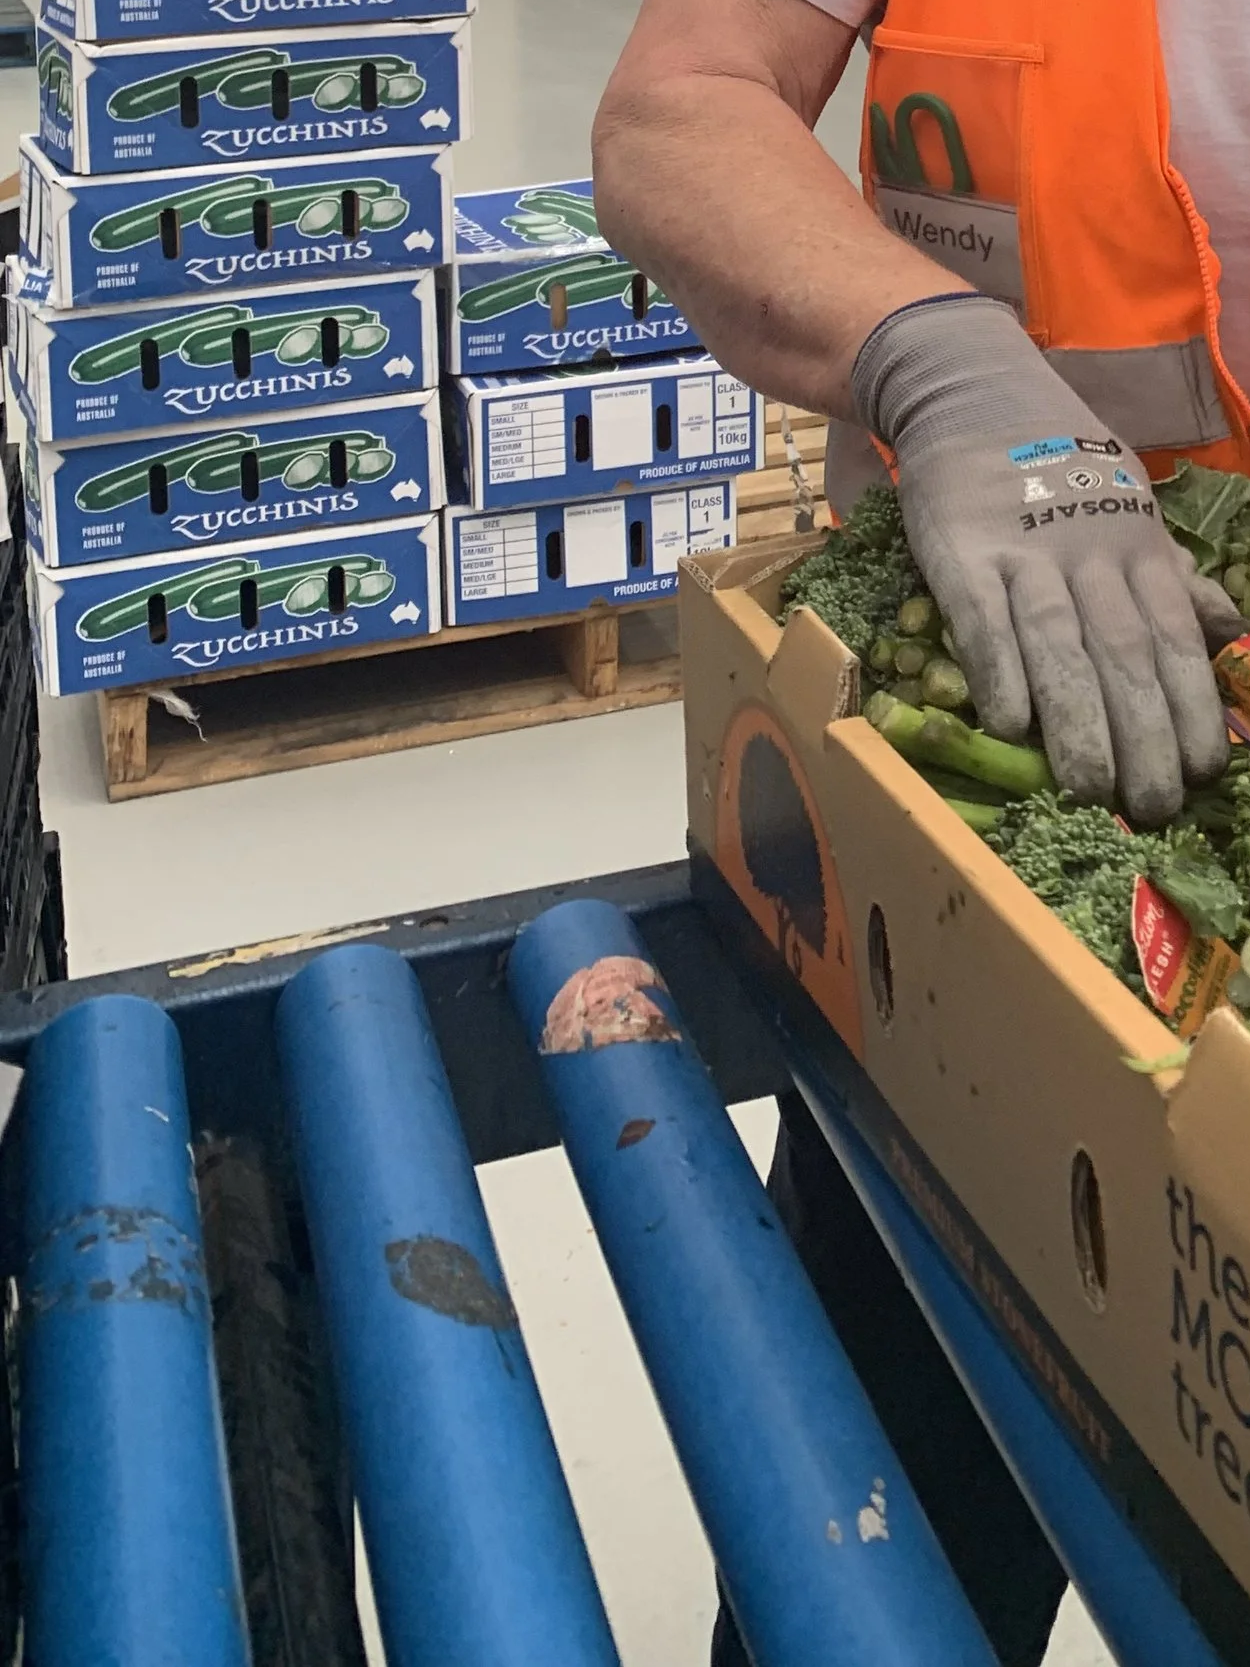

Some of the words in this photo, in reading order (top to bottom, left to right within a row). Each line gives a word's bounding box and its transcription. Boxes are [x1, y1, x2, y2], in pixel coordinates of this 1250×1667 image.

[119, 0, 152, 10] PRODUCE
[120, 11, 159, 22] AUSTRALIA
[113, 135, 145, 146] PRODUCE
[201, 116, 388, 157] ZUCCHINIS
[114, 147, 153, 158] AUSTRALIA
[894, 208, 994, 262] Wendy
[185, 240, 372, 284] ZUCCHINIS
[96, 264, 128, 276] PRODUCE
[97, 276, 136, 288] AUSTRALIA
[523, 317, 689, 359] ZUCCHINIS
[468, 345, 503, 357] AUSTRALIA
[164, 368, 352, 414] ZUCCHINIS
[717, 382, 748, 394] CLASS
[76, 397, 108, 409] PRODUCE
[511, 402, 529, 411] SIZE
[729, 396, 735, 408] 1
[76, 409, 116, 422] AUSTRALIA
[491, 416, 515, 425] SMALL
[491, 429, 522, 439] SM/MED
[719, 432, 747, 446] 10kg
[491, 443, 522, 453] MEDIUM
[491, 456, 524, 466] MED/LGE
[639, 465, 683, 479] PRODUCE
[686, 462, 698, 472] OF
[700, 454, 750, 471] AUSTRALIA
[492, 471, 516, 480] LARGE
[691, 496, 722, 510] CLASS
[171, 492, 359, 540] ZUCCHINIS
[703, 511, 709, 523] 1
[1020, 497, 1154, 531] PROSAFE
[483, 520, 500, 528] SIZE
[82, 526, 115, 538] PRODUCE
[83, 537, 122, 549] AUSTRALIA
[462, 534, 487, 543] SMALL
[462, 546, 494, 556] SM/MED
[463, 560, 494, 569] MEDIUM
[463, 573, 496, 583] MED/LGE
[464, 588, 488, 597] LARGE
[614, 580, 657, 596] PRODUCE
[660, 577, 673, 588] OF
[172, 616, 359, 667] ZUCCHINIS
[83, 653, 115, 666] PRODUCE
[84, 665, 123, 678] AUSTRALIA
